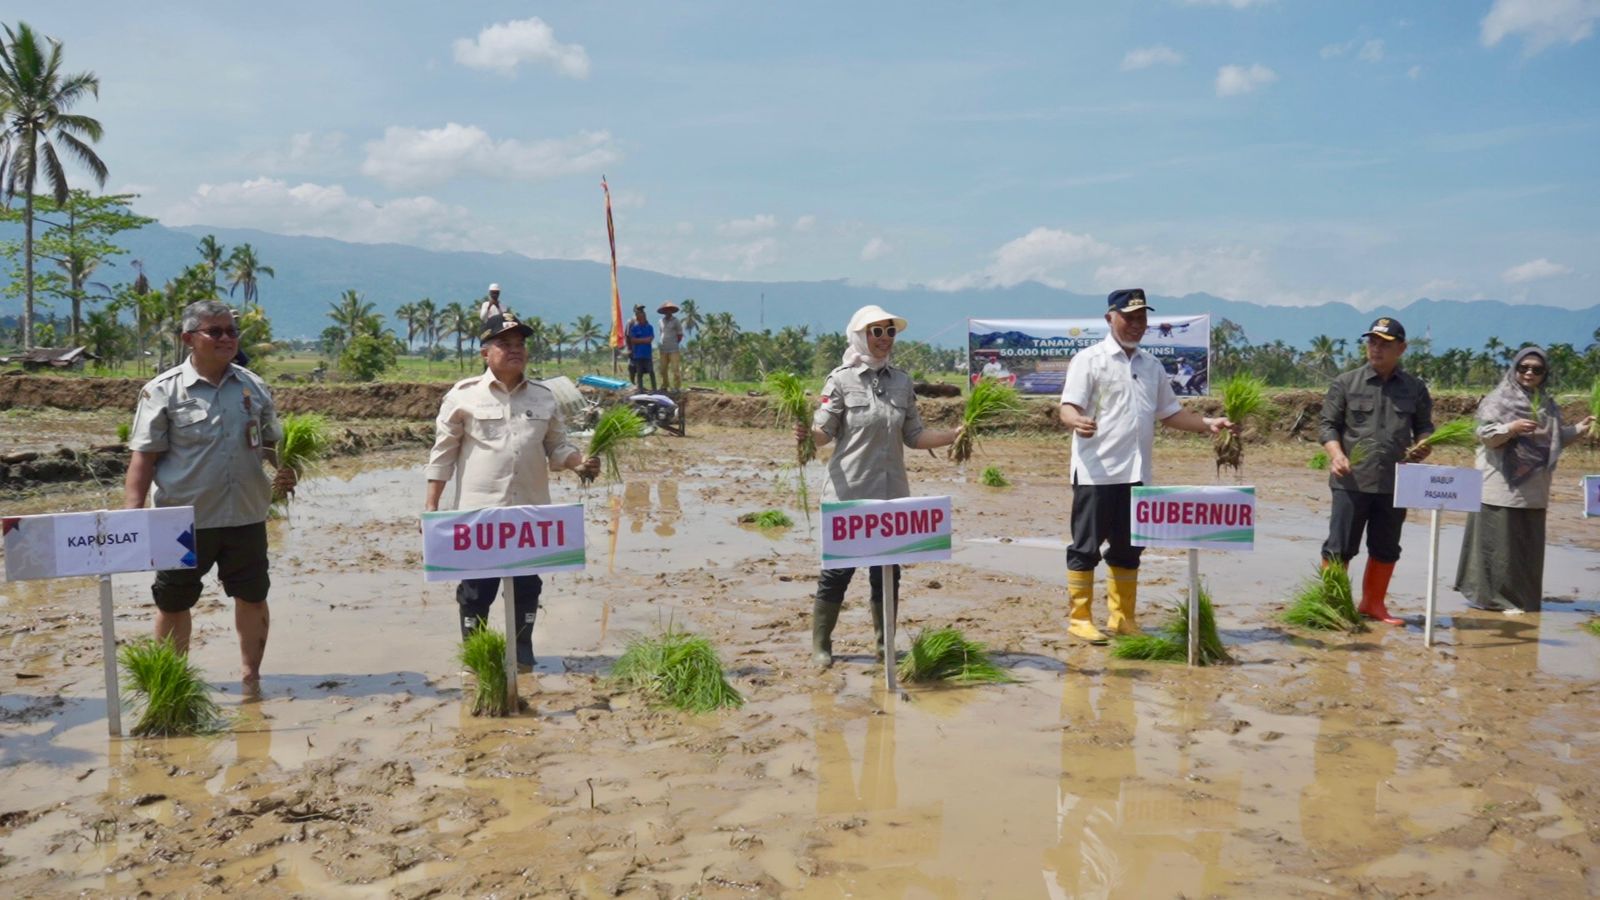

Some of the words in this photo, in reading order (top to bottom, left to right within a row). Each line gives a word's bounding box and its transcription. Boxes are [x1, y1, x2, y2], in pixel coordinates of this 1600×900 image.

[1032, 339, 1075, 347] TANAM
[1000, 348, 1039, 357] 50.000
[1040, 348, 1083, 357] HEKTA
[1424, 490, 1457, 499] PASAMAN
[1136, 501, 1252, 526] GUBERNUR
[832, 508, 944, 541] BPPSDMP
[68, 532, 139, 547] KAPUSLAT
[453, 520, 564, 551] BUPATI
